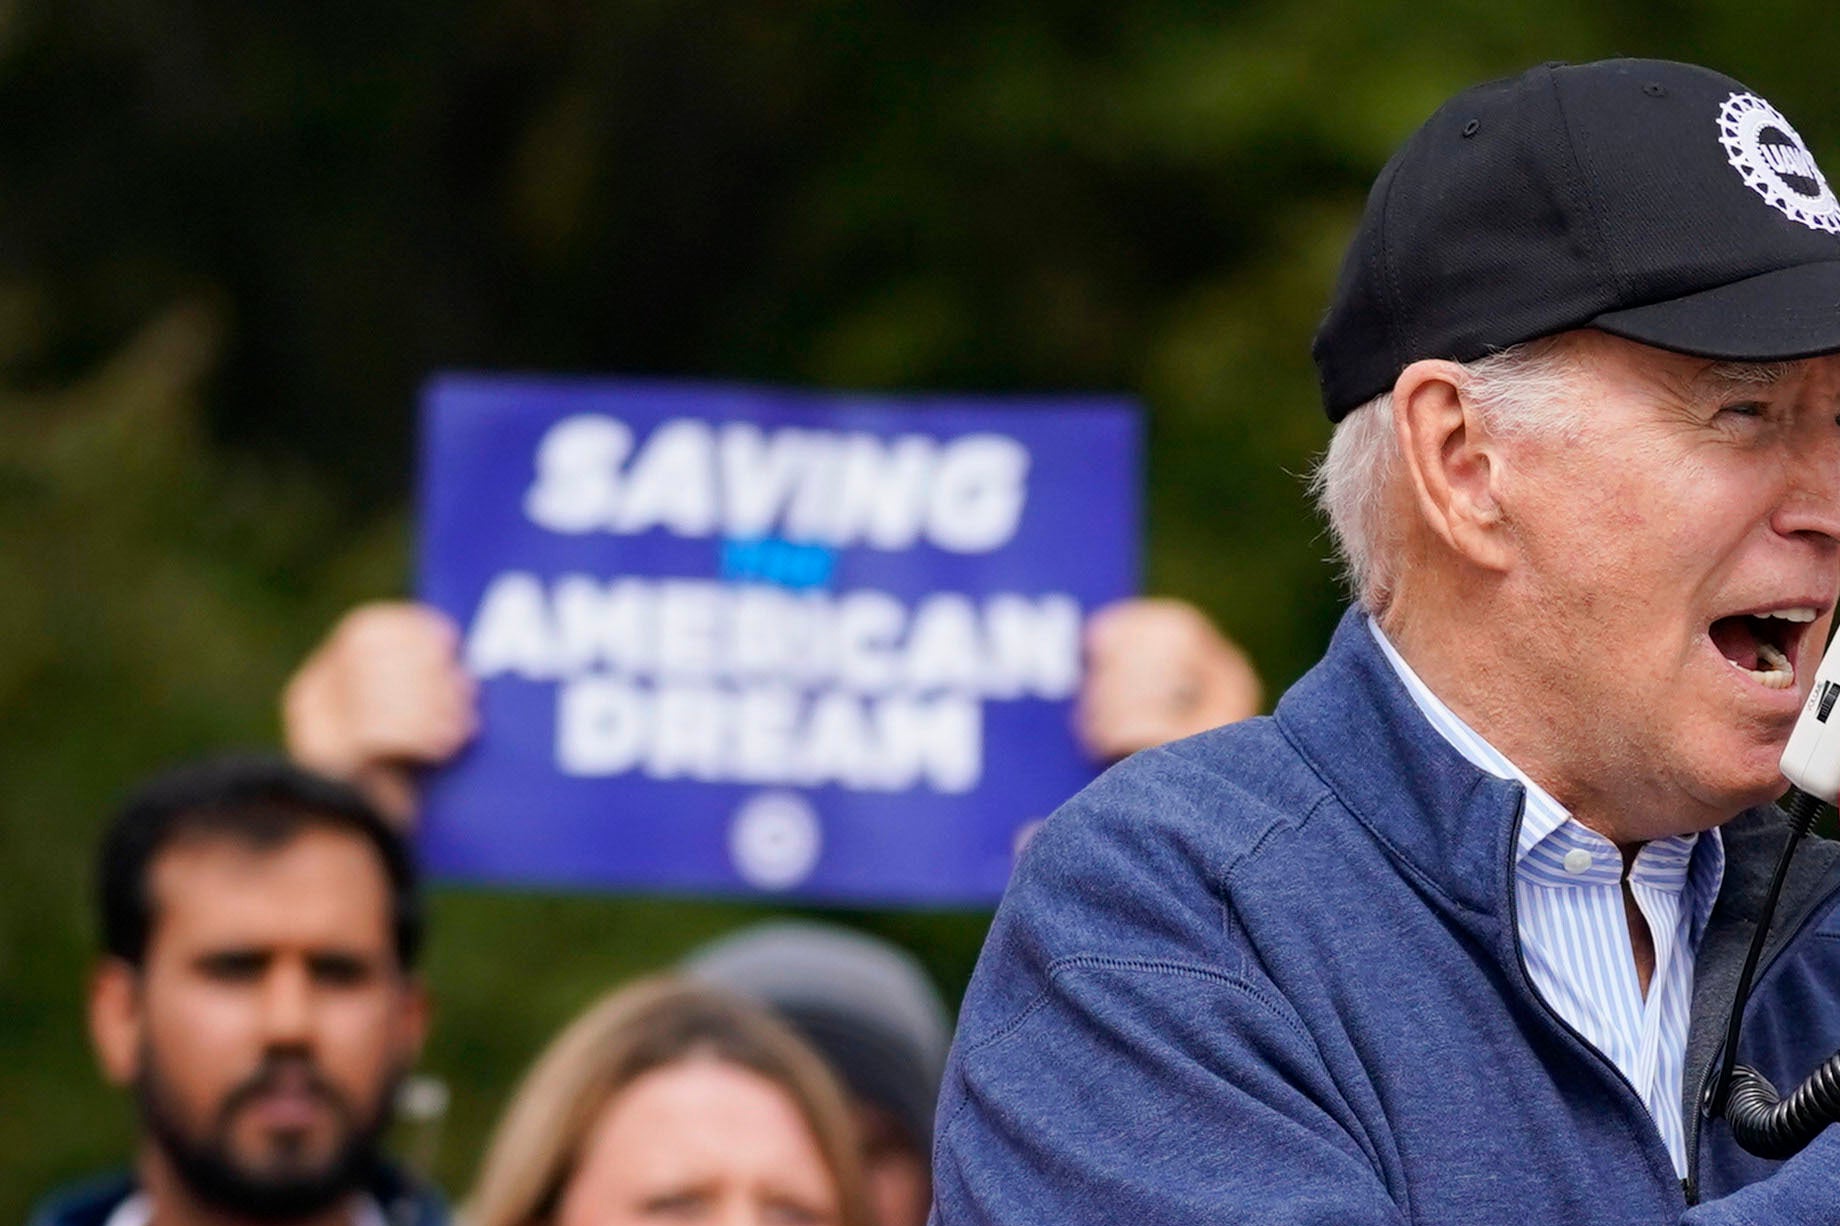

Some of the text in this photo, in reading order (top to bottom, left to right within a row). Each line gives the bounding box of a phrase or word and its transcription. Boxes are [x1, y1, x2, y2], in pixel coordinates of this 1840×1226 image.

[524, 413, 1031, 554] SAVING
[465, 572, 1083, 702] AMERICAN
[556, 676, 984, 793] DREAM
